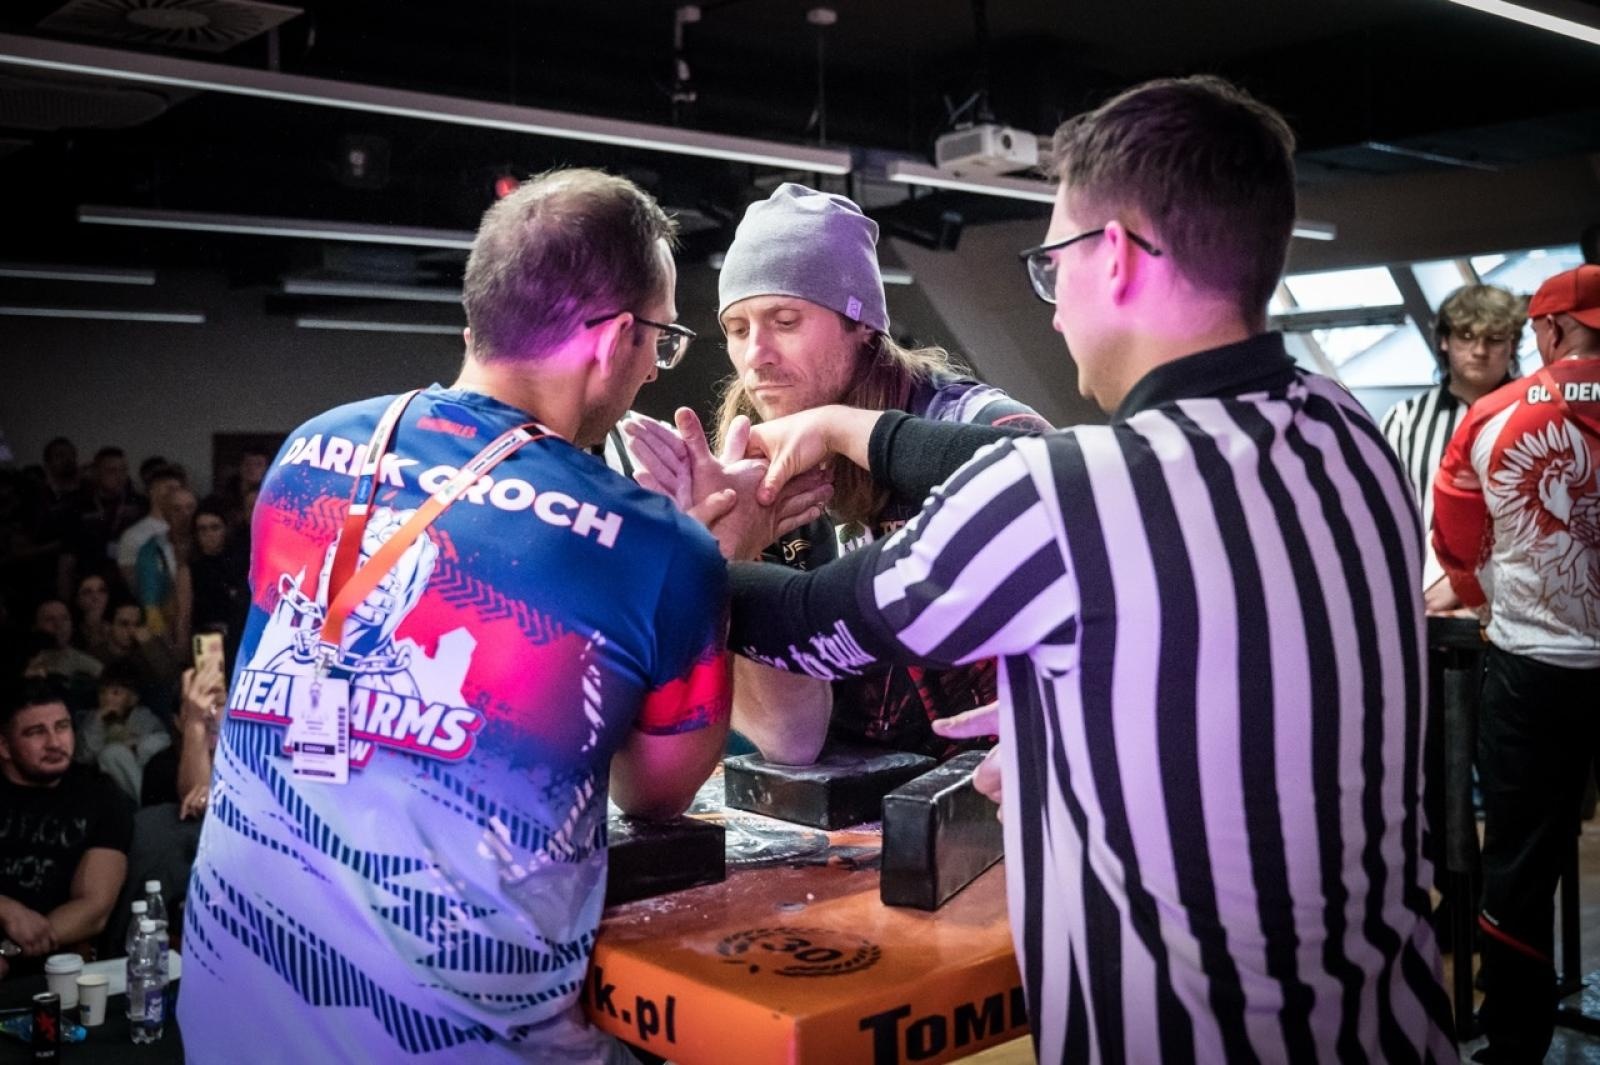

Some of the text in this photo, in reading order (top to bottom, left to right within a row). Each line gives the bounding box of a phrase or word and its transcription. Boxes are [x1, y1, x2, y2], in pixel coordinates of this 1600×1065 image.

[1527, 382, 1600, 405] GODEN
[418, 464, 624, 548] GROCH
[594, 965, 676, 1045] k.pl
